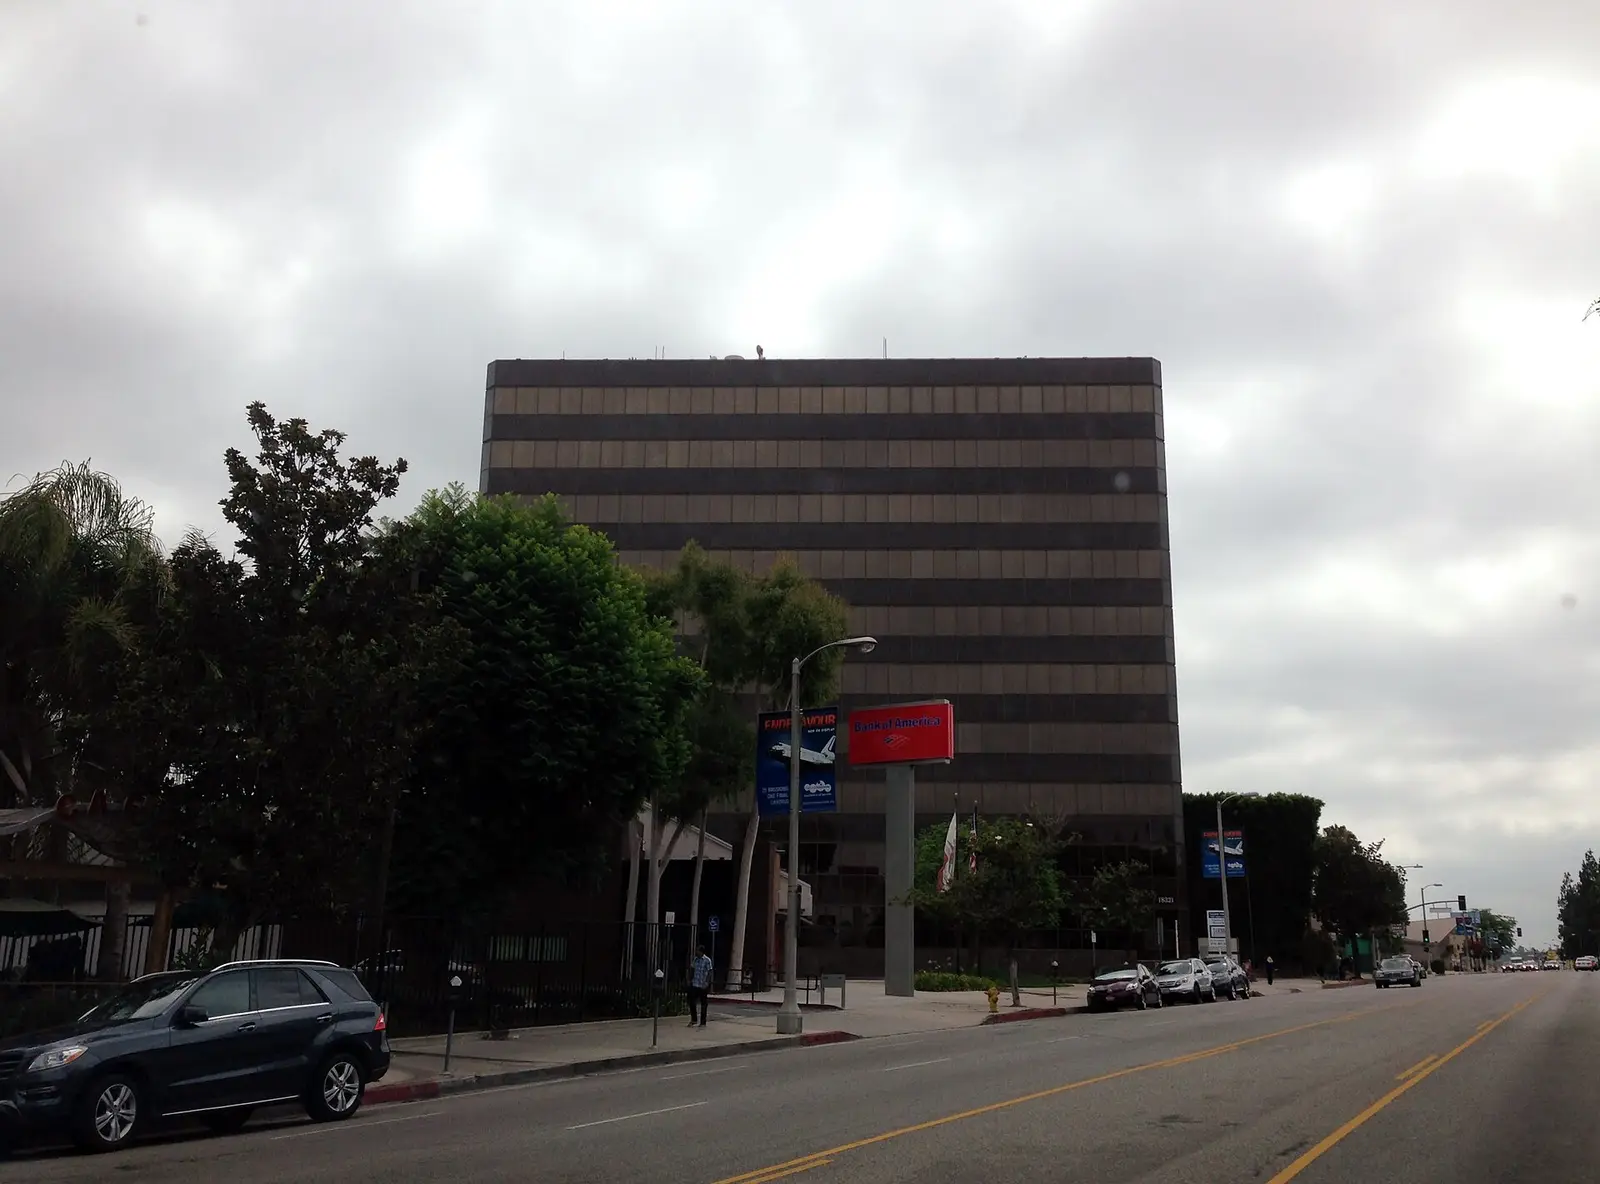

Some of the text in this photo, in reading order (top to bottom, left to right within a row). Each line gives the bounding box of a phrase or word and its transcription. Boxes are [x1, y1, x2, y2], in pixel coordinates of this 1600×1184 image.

[855, 715, 940, 732] Bank of America
